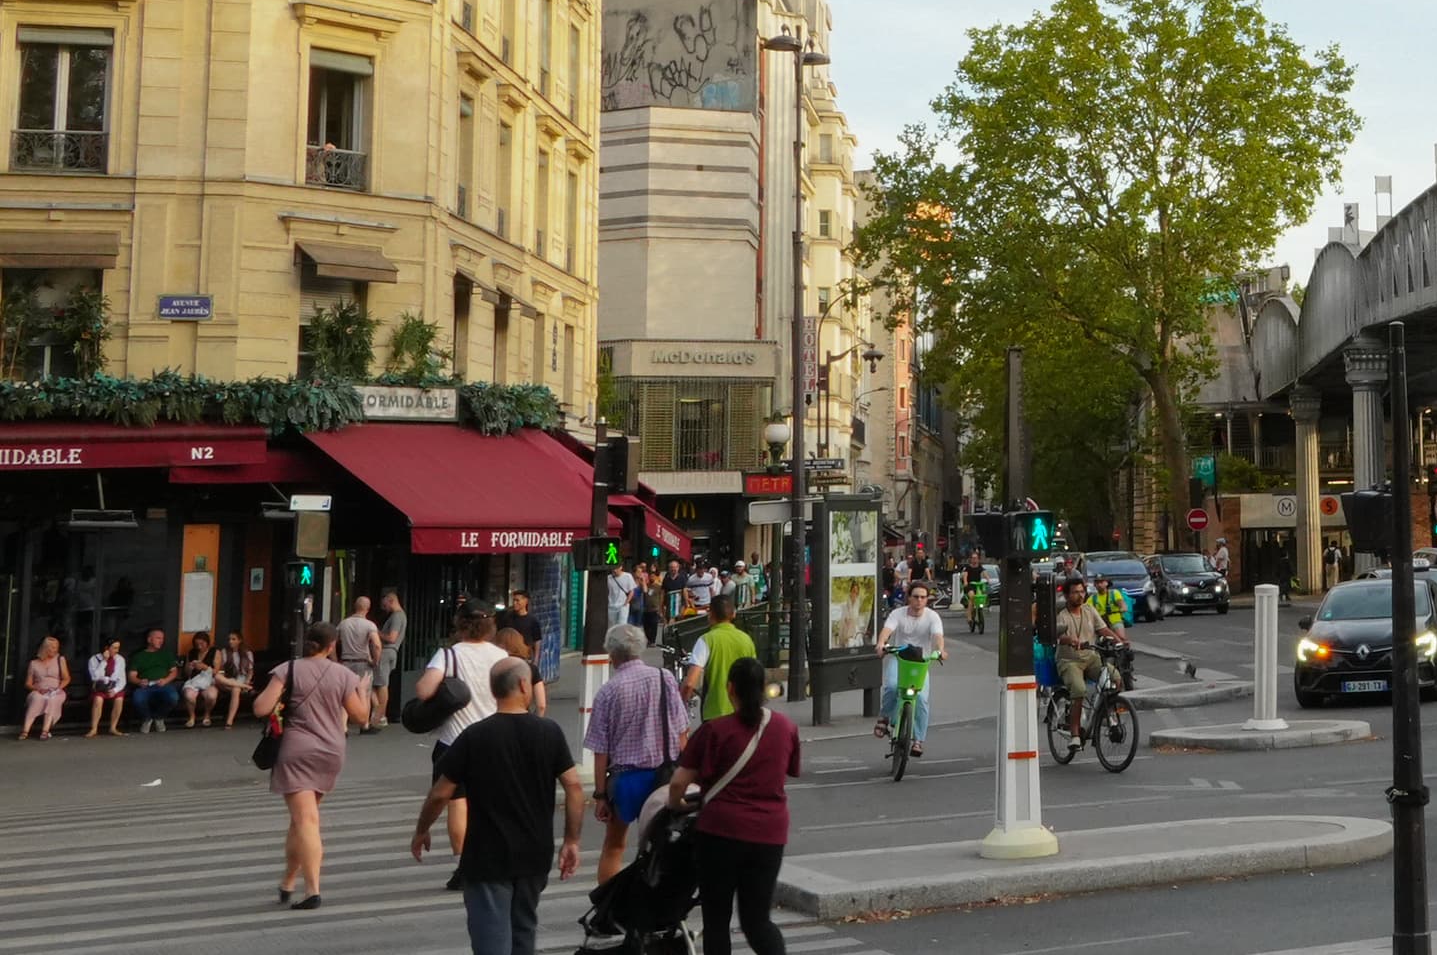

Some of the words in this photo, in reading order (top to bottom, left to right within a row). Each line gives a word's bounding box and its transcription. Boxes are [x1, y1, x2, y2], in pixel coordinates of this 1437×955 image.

[172, 299, 199, 307] AVENUE
[160, 307, 180, 315] JEAN
[651, 348, 756, 365] McDonald's
[804, 315, 815, 392] HOTEL
[367, 394, 449, 409] ORMIDABLE
[191, 447, 214, 460] N2
[749, 476, 790, 493] METR
[461, 533, 479, 548] LE
[491, 532, 573, 548] FORMIDABLE
